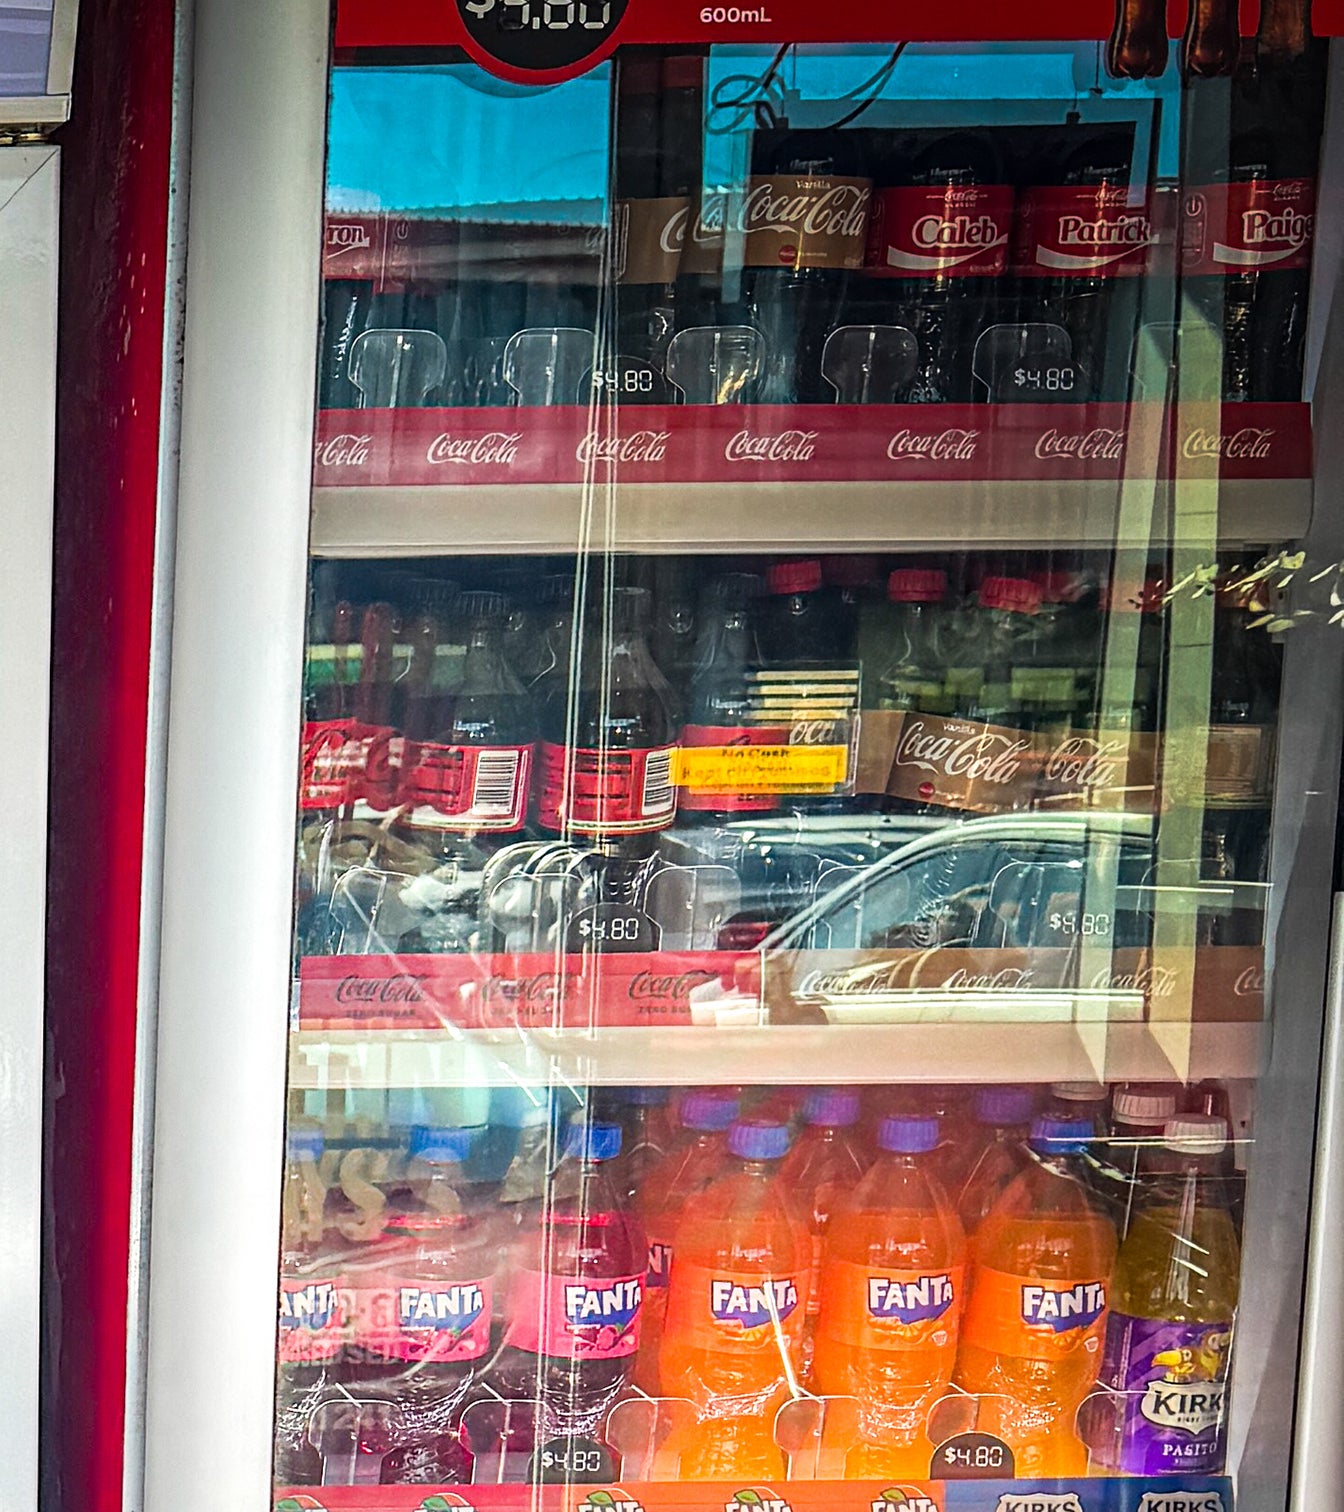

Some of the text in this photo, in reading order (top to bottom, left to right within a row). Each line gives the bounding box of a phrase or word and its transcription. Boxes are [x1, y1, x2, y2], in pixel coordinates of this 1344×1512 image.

[700, 7, 772, 23] 600mL
[912, 216, 998, 247] Caleb
[1059, 216, 1151, 246] Patrick
[1243, 208, 1312, 246] Paige
[592, 369, 653, 393] $4.80
[1014, 367, 1075, 391] $4.80
[427, 433, 523, 466] Coca-Cola
[576, 431, 672, 464] Coca-Cola
[725, 430, 820, 463] Coca-Cola
[887, 429, 982, 462] Coca-Cola
[1035, 427, 1130, 460] Coca-Cola
[1182, 427, 1277, 460] Coca-Cola
[896, 721, 1033, 785] Coca-Cola
[579, 918, 640, 941] $4.80
[1050, 913, 1110, 935] $4.80
[280, 1284, 338, 1317] ANTA
[400, 1284, 484, 1319] FANTA
[565, 1281, 642, 1318] FANTA
[712, 1279, 798, 1314] FANTA
[868, 1276, 953, 1311] FANTA
[1022, 1283, 1106, 1318] FANTA
[541, 1451, 601, 1473] $4.80
[944, 1447, 1003, 1469] $4.80
